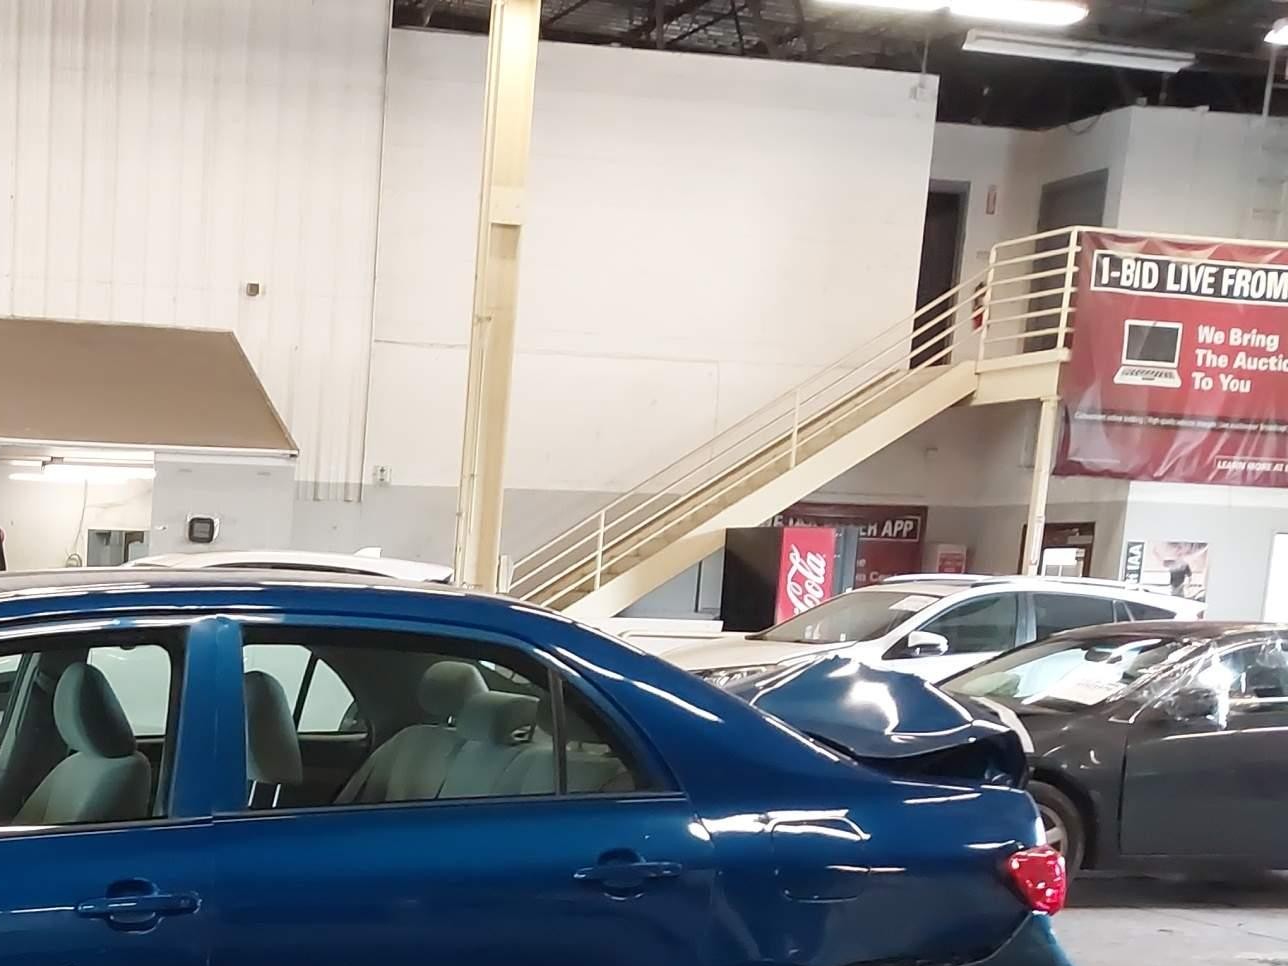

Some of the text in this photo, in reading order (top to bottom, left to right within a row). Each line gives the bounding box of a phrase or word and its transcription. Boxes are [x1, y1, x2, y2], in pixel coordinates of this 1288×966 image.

[1100, 256, 1288, 300] I-BID LIVE FROM
[1197, 324, 1280, 352] We Bring
[1194, 348, 1229, 368] The
[1191, 371, 1252, 393] To You
[881, 519, 914, 538] APP
[1127, 544, 1143, 571] IAA
